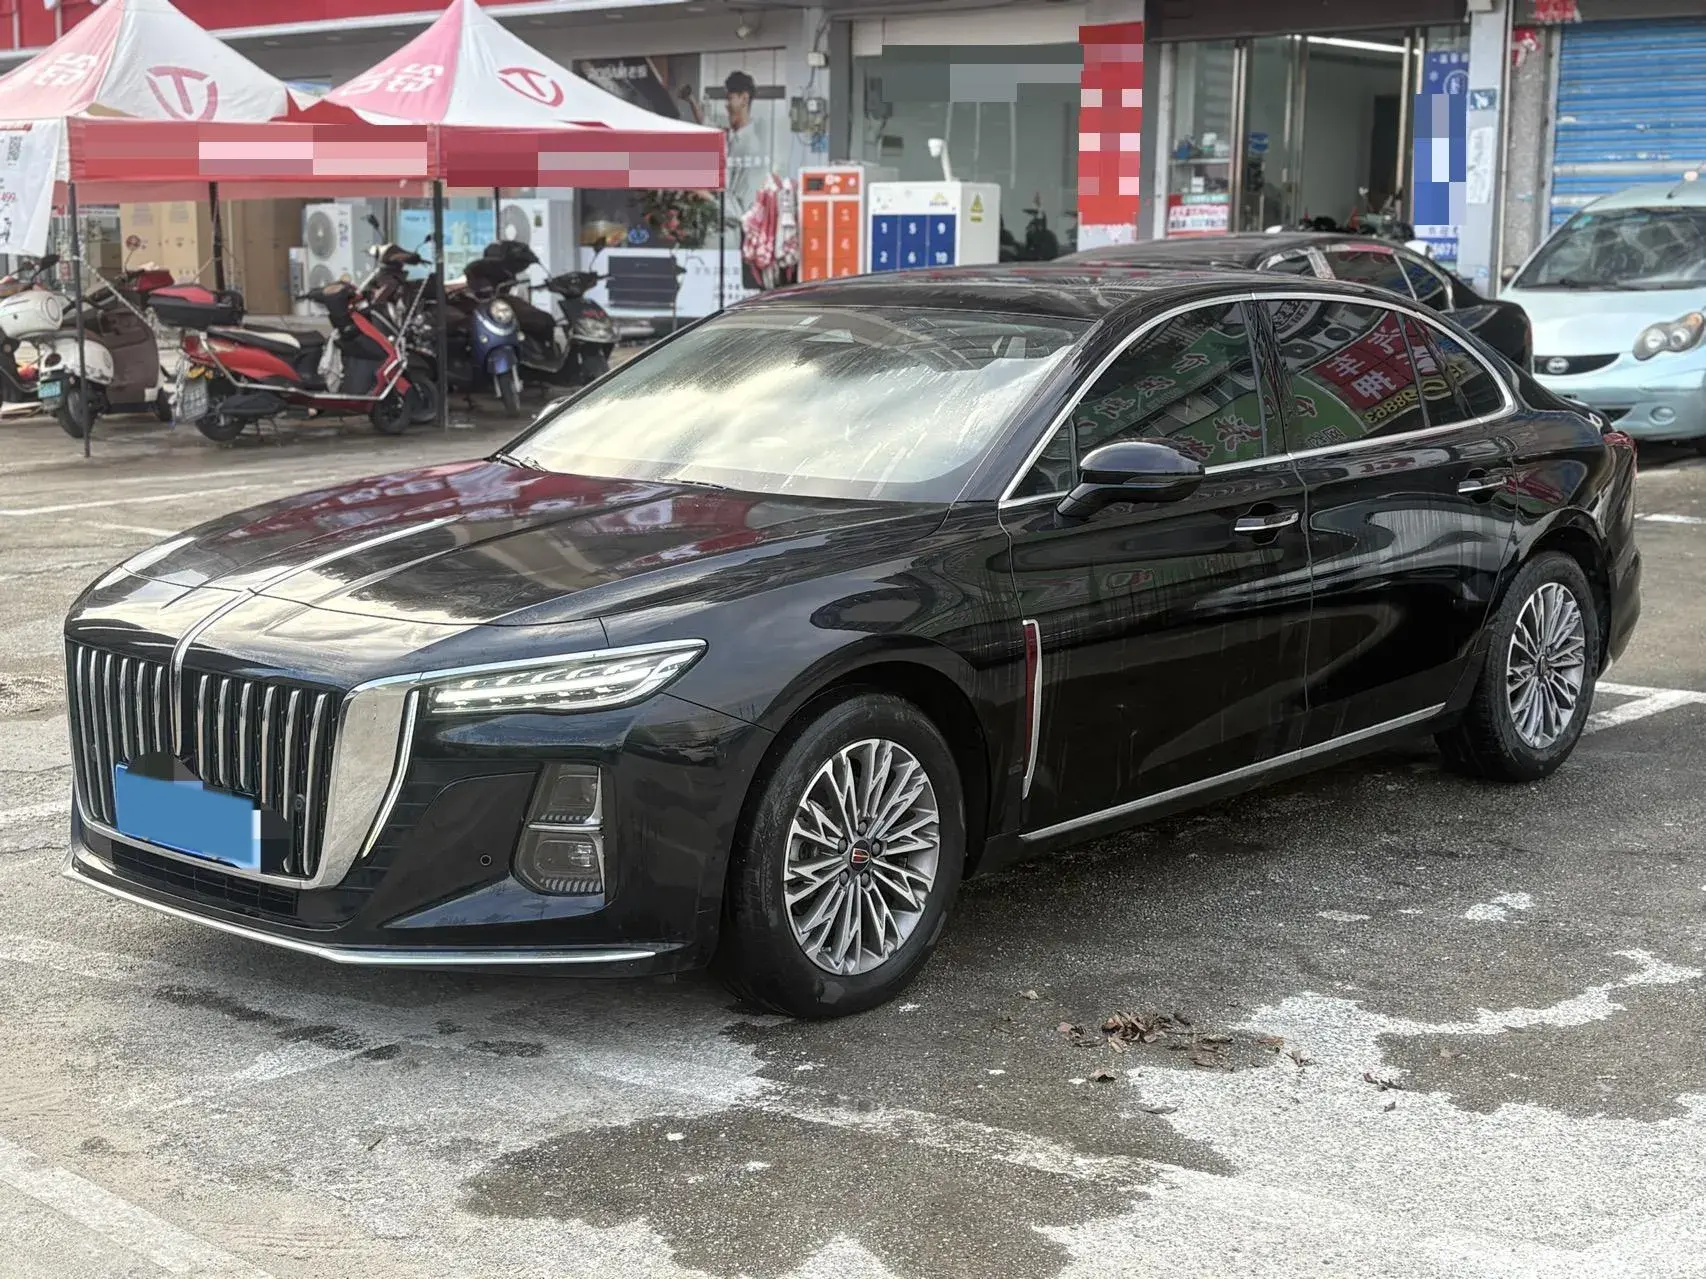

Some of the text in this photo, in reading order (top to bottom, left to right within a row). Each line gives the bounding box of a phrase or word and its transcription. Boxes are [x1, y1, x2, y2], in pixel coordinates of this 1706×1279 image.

[881, 222, 888, 234] 1
[908, 222, 917, 235] 5
[937, 222, 946, 234] 9
[880, 251, 888, 263] 2
[907, 251, 917, 264] 6
[935, 250, 949, 264] 10
